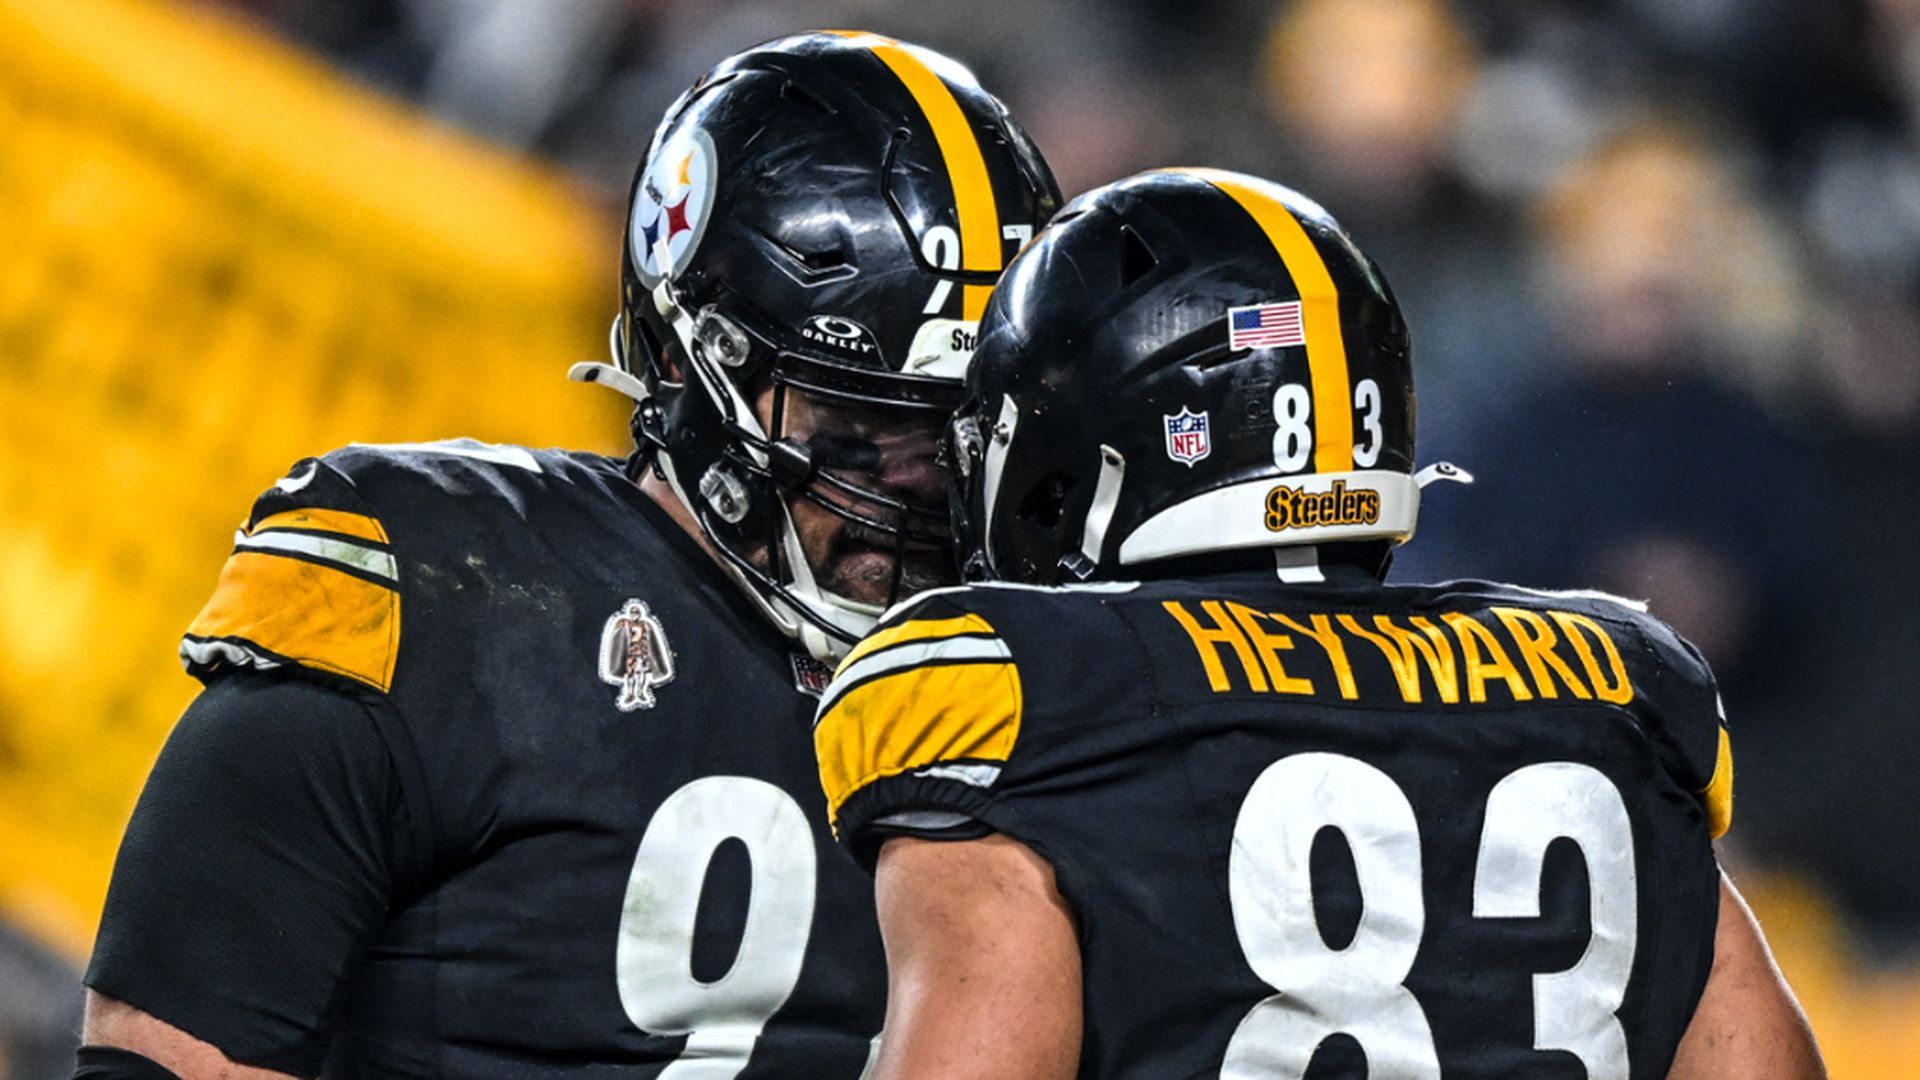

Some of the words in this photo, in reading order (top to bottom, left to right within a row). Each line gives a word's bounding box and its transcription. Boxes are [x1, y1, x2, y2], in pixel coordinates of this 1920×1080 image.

[802, 328, 872, 353] OAKLEY
[1173, 433, 1205, 456] NFL
[1265, 481, 1380, 531] Steelers
[1162, 600, 1634, 705] HEYWARD
[1219, 752, 1638, 1080] 83
